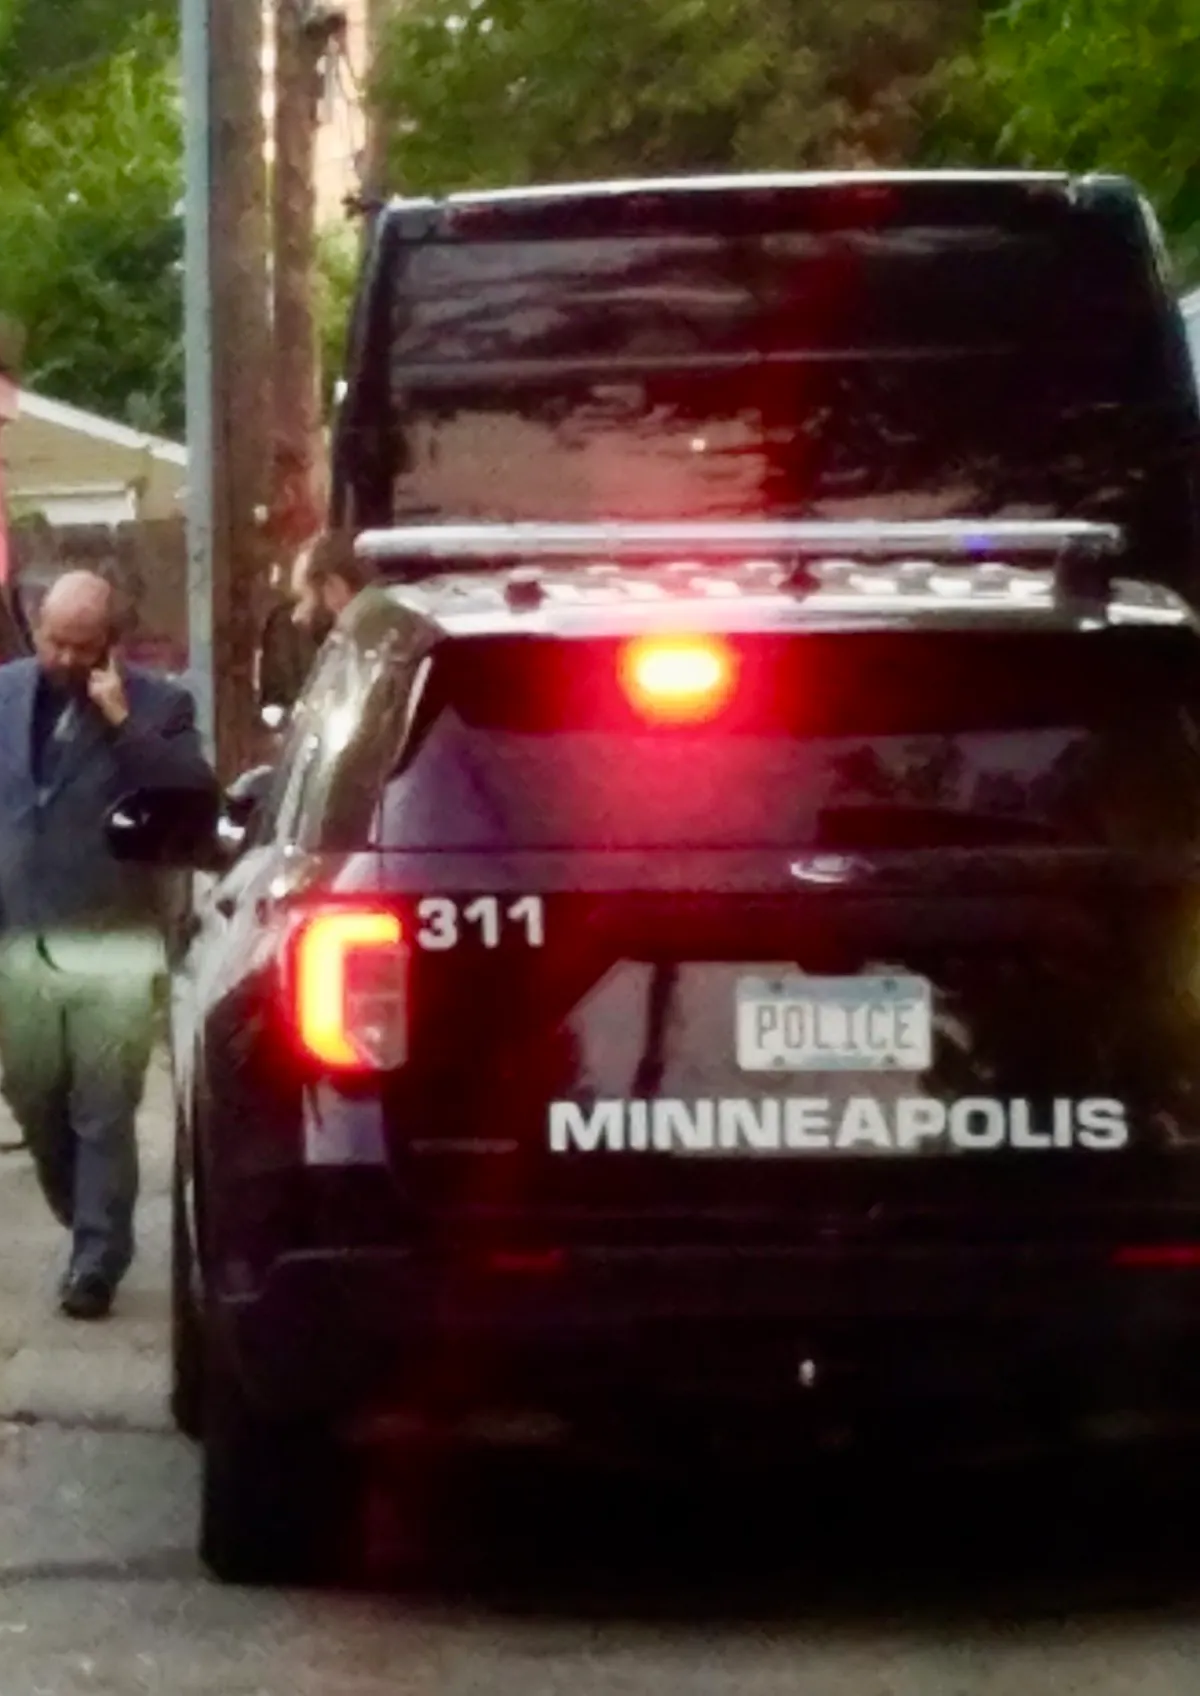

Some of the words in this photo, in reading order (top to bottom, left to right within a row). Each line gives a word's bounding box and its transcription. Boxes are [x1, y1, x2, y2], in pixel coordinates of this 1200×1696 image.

[417, 896, 545, 950] 311
[757, 1003, 916, 1050] POLICE
[548, 1098, 1128, 1152] MINNEAPOLIS
